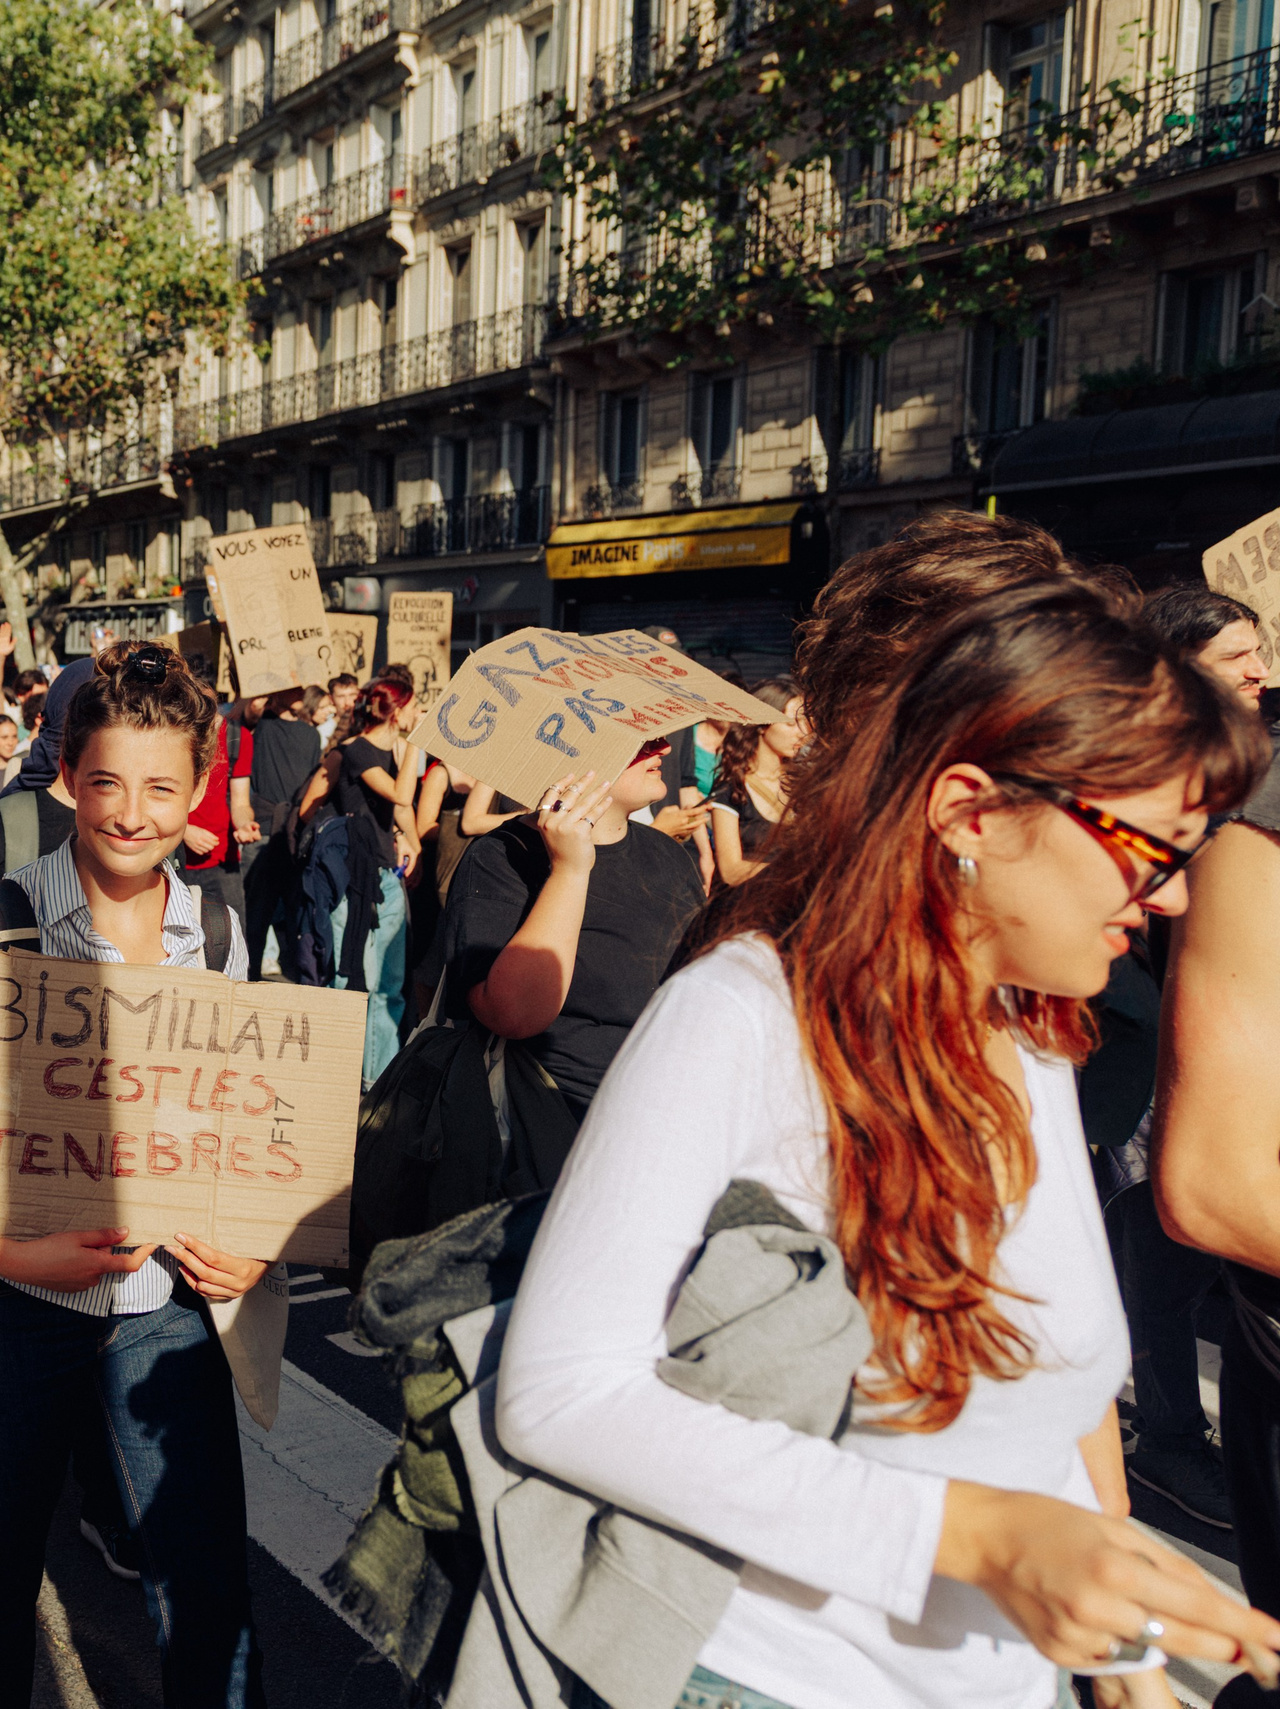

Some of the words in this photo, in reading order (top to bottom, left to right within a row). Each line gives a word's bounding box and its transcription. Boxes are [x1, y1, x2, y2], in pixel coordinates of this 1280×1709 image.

[216, 539, 258, 560] VOUS
[264, 533, 305, 550] VOYEZ
[571, 544, 640, 567] IMAGINE
[643, 538, 685, 562] Paris
[290, 568, 312, 581] UN
[392, 611, 445, 623] CULTURELLE
[534, 687, 626, 759] PAS
[187, 1066, 276, 1117] LES
